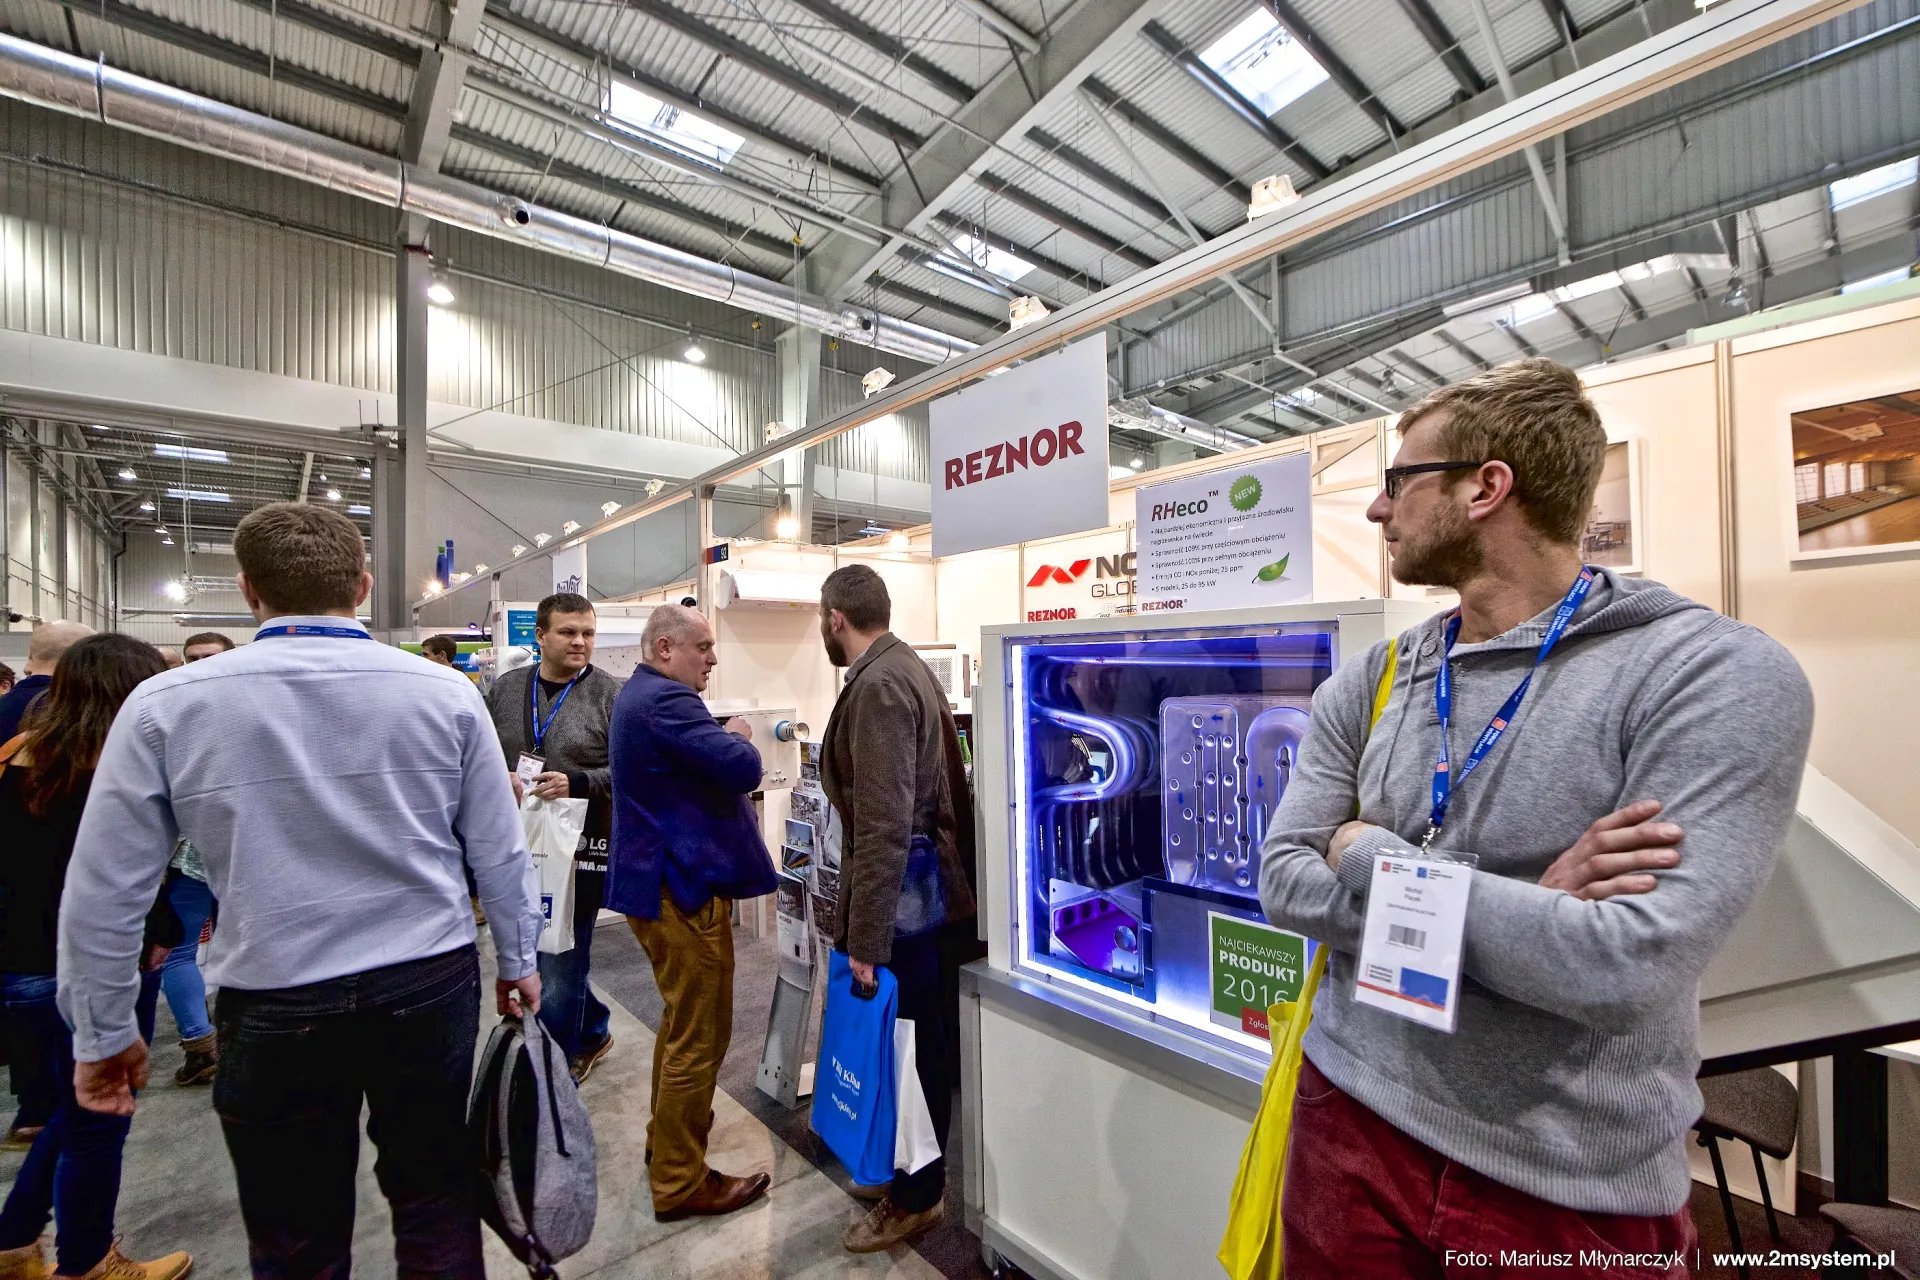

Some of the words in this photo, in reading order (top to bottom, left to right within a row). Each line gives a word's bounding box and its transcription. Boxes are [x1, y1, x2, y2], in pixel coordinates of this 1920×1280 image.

[945, 420, 1085, 491] REZNOR
[1234, 484, 1257, 502] NEW
[1185, 518, 1223, 530] ekonomiczna
[1227, 513, 1256, 524] przyjazna
[1257, 506, 1294, 518] środowisku
[1155, 546, 1184, 557] Sprawność
[1185, 544, 1200, 553] 109%
[1201, 543, 1214, 551] przy
[1214, 538, 1250, 549] częściowym
[1251, 532, 1286, 544] obciążeniu
[1192, 530, 1214, 539] świecie
[1155, 558, 1185, 569] Sprawność
[1201, 556, 1214, 564] przy
[1215, 553, 1237, 561] pełnym
[1238, 547, 1272, 558] obciążeniu
[1155, 573, 1173, 581] Emisja
[1185, 569, 1198, 577] NOx
[1198, 567, 1220, 577] poniżej
[1220, 565, 1229, 573] 25
[1229, 564, 1244, 574] ppm
[1181, 582, 1189, 590] 25
[1189, 581, 1197, 589] do
[1206, 579, 1217, 587] kW
[1027, 607, 1077, 623] REZNOR
[589, 837, 607, 851] LG
[1219, 935, 1296, 965] NAJCIEKAWSZY
[1219, 949, 1297, 984] PRODUKT
[1223, 973, 1289, 1007] 2016
